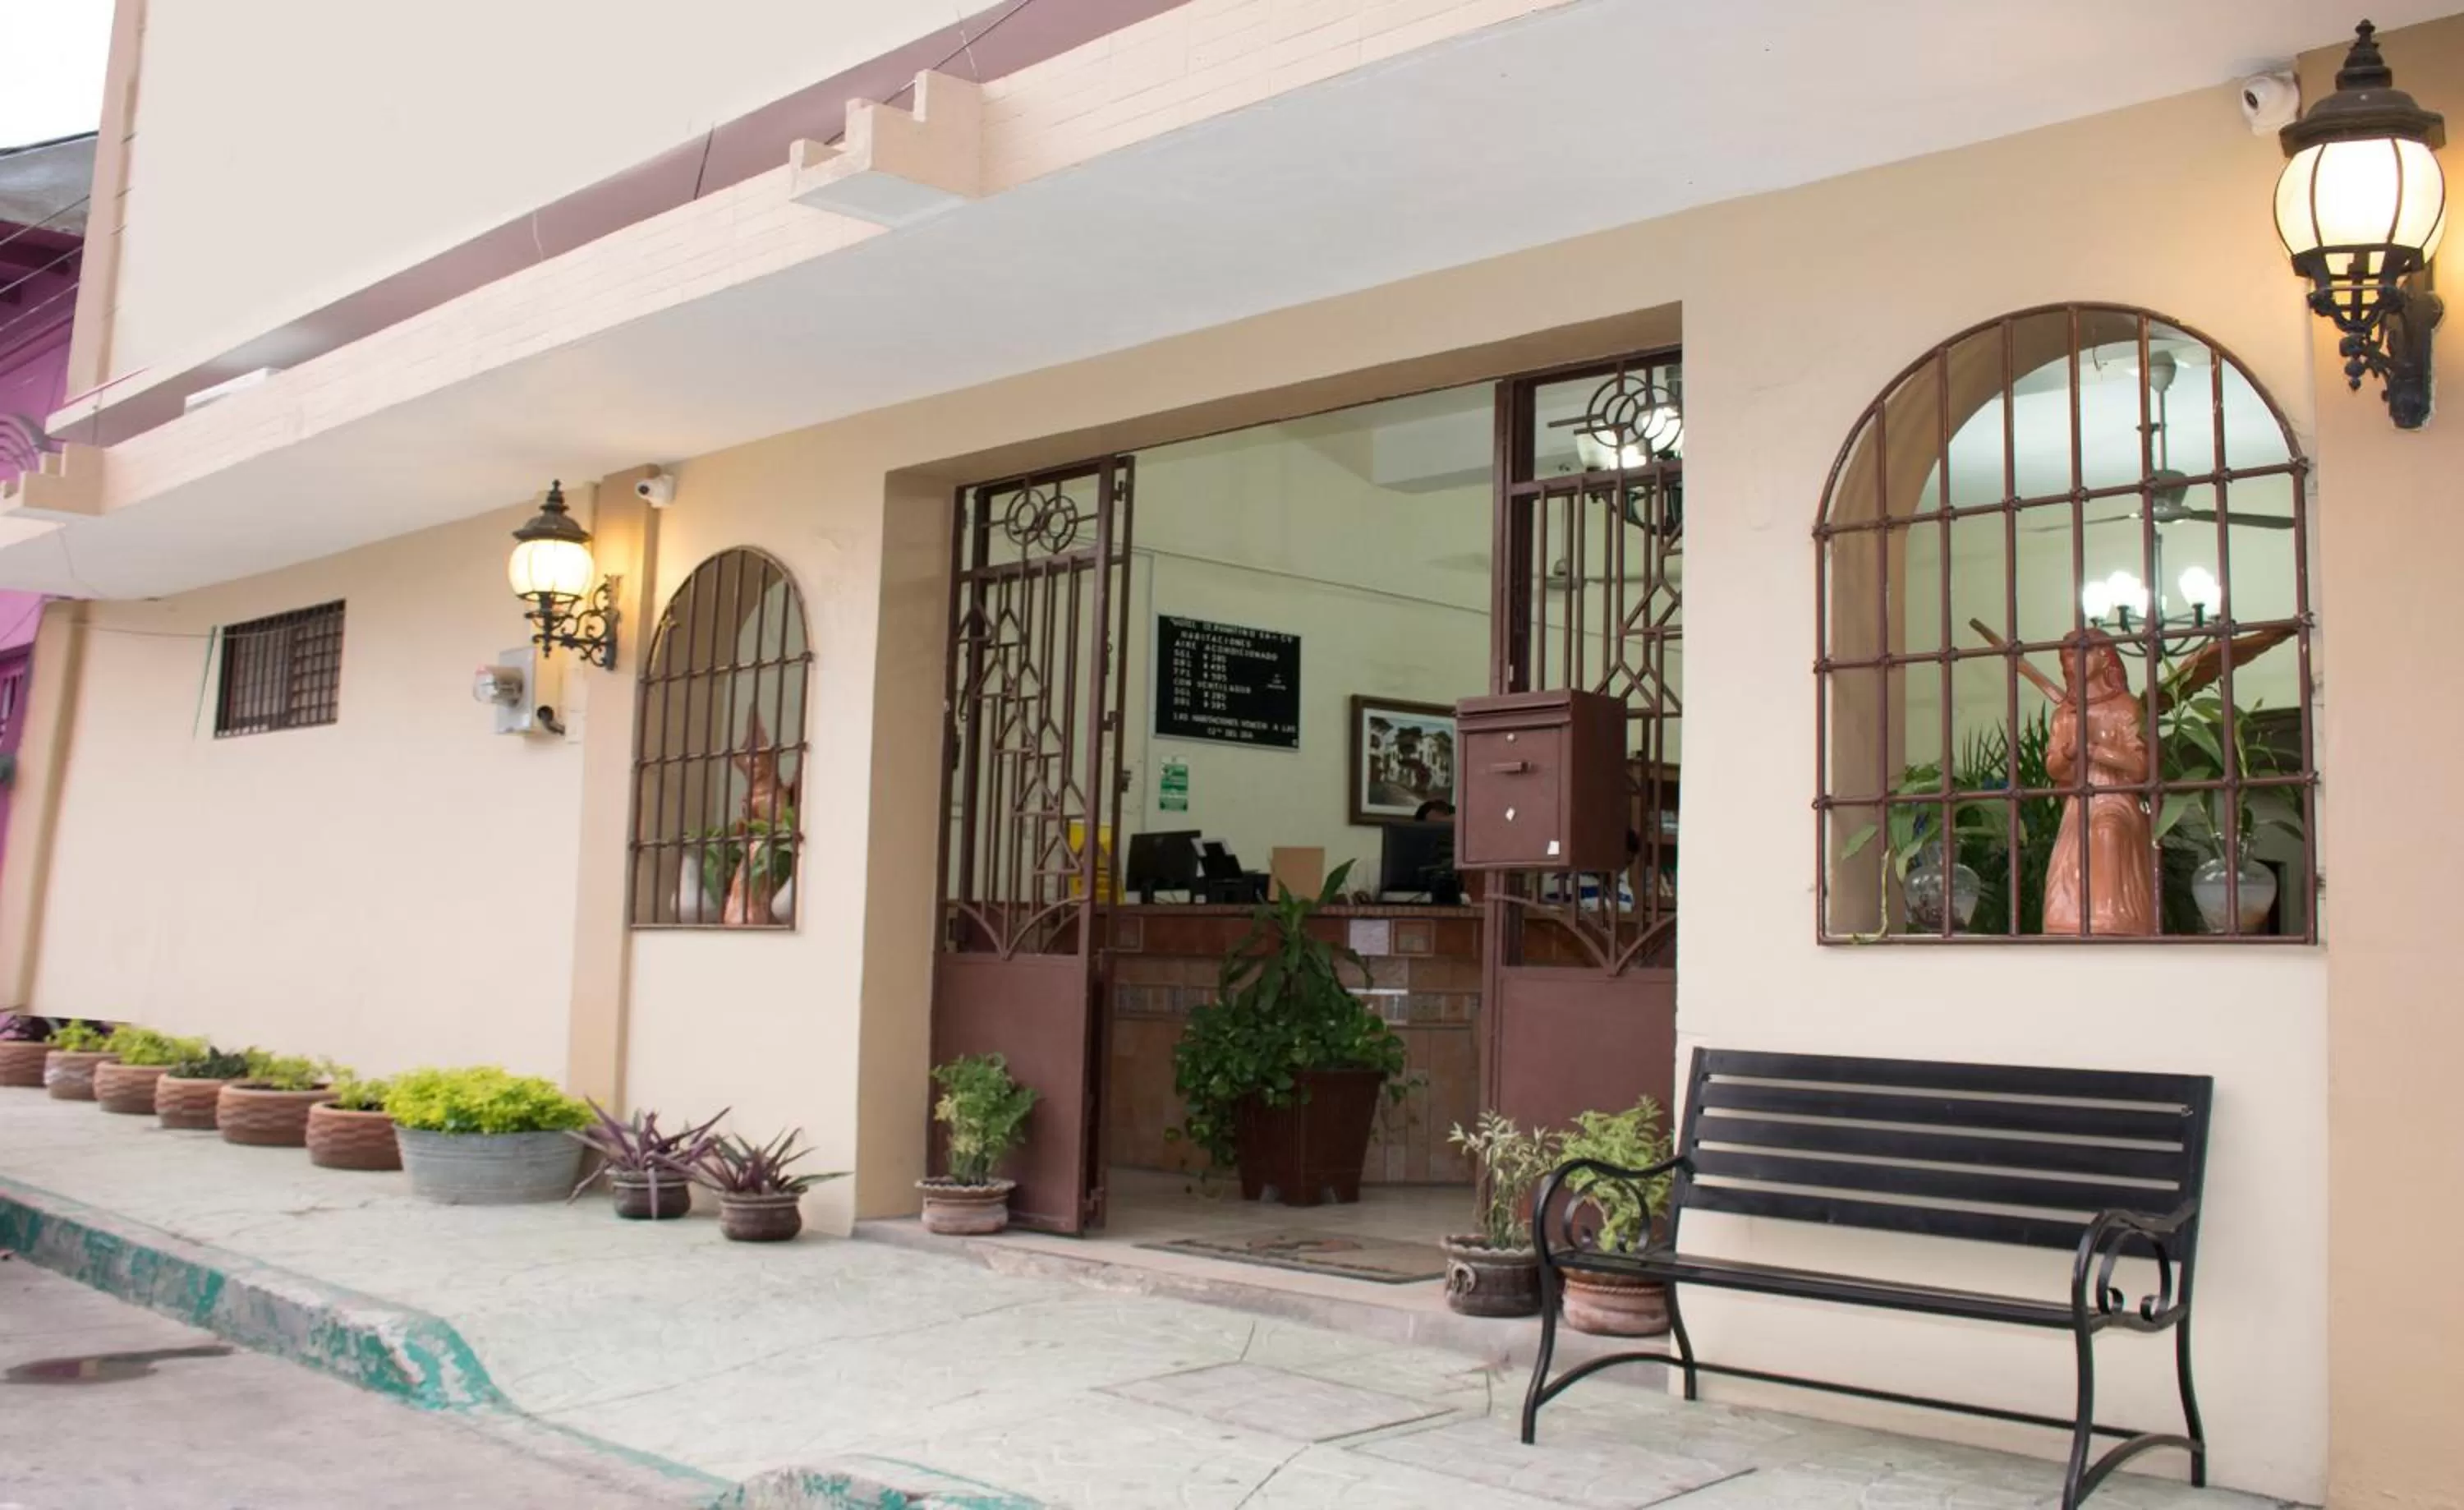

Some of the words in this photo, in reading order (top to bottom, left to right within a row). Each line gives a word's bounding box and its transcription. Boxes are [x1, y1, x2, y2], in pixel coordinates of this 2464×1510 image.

[1180, 630, 1252, 648] HABITACIONES
[1175, 638, 1196, 650] AIRE
[1204, 643, 1278, 661] ACONDICIONADO
